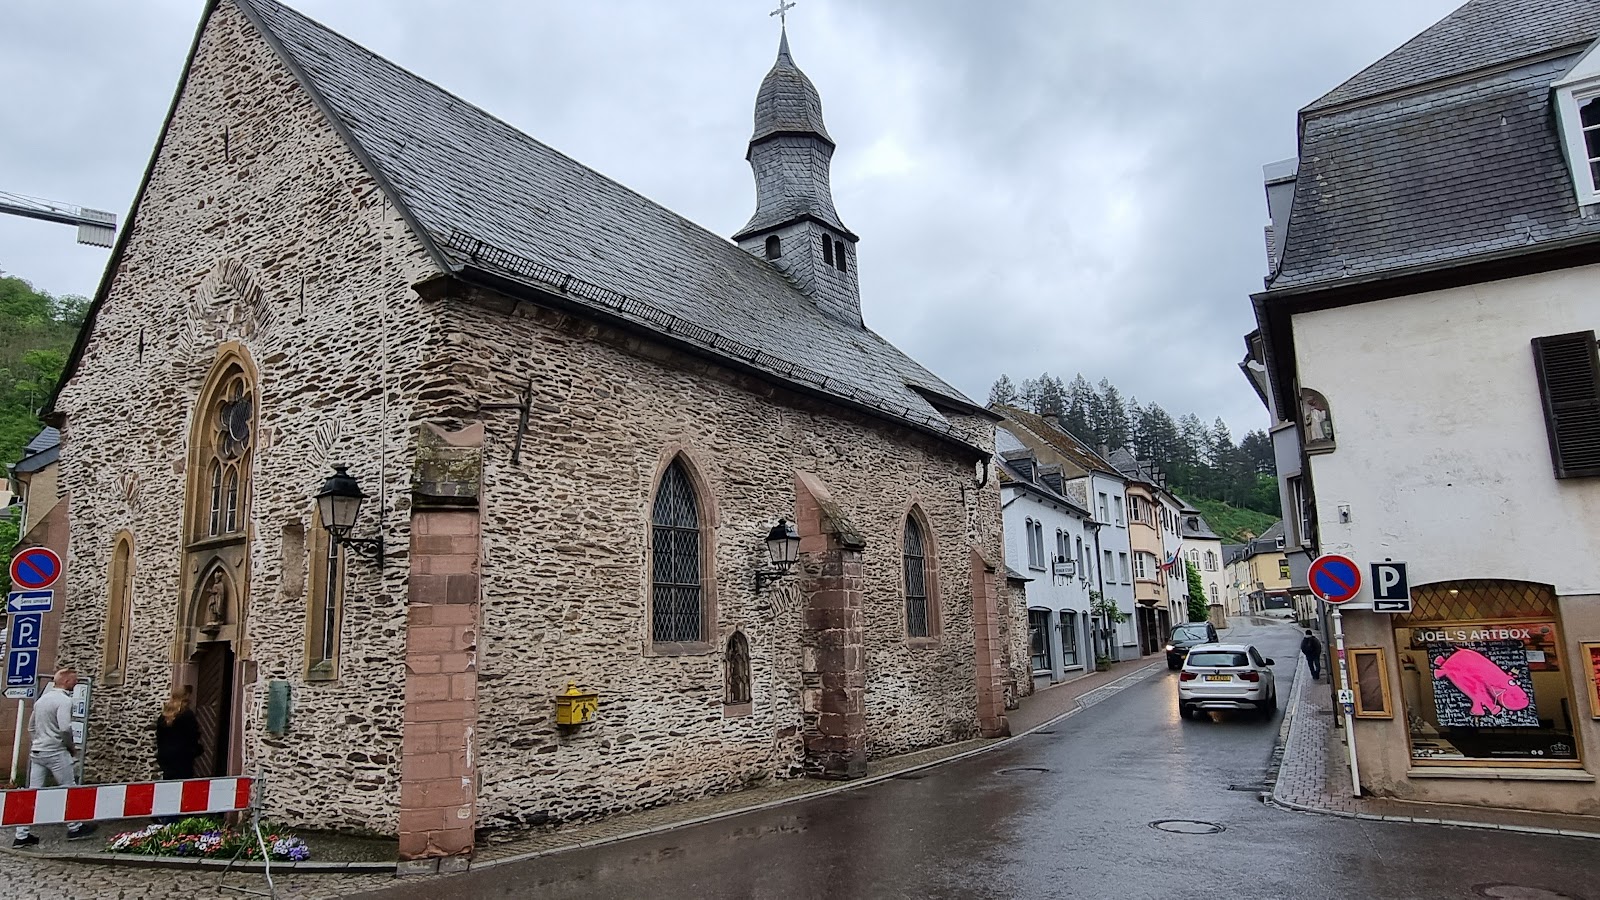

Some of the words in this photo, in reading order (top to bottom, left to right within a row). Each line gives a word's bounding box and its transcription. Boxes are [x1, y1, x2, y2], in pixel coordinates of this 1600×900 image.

[1378, 566, 1400, 597] P
[19, 623, 33, 645] P
[1418, 630, 1466, 642] JOEL'S
[1470, 628, 1531, 640] ARTBOX
[15, 652, 30, 675] P
